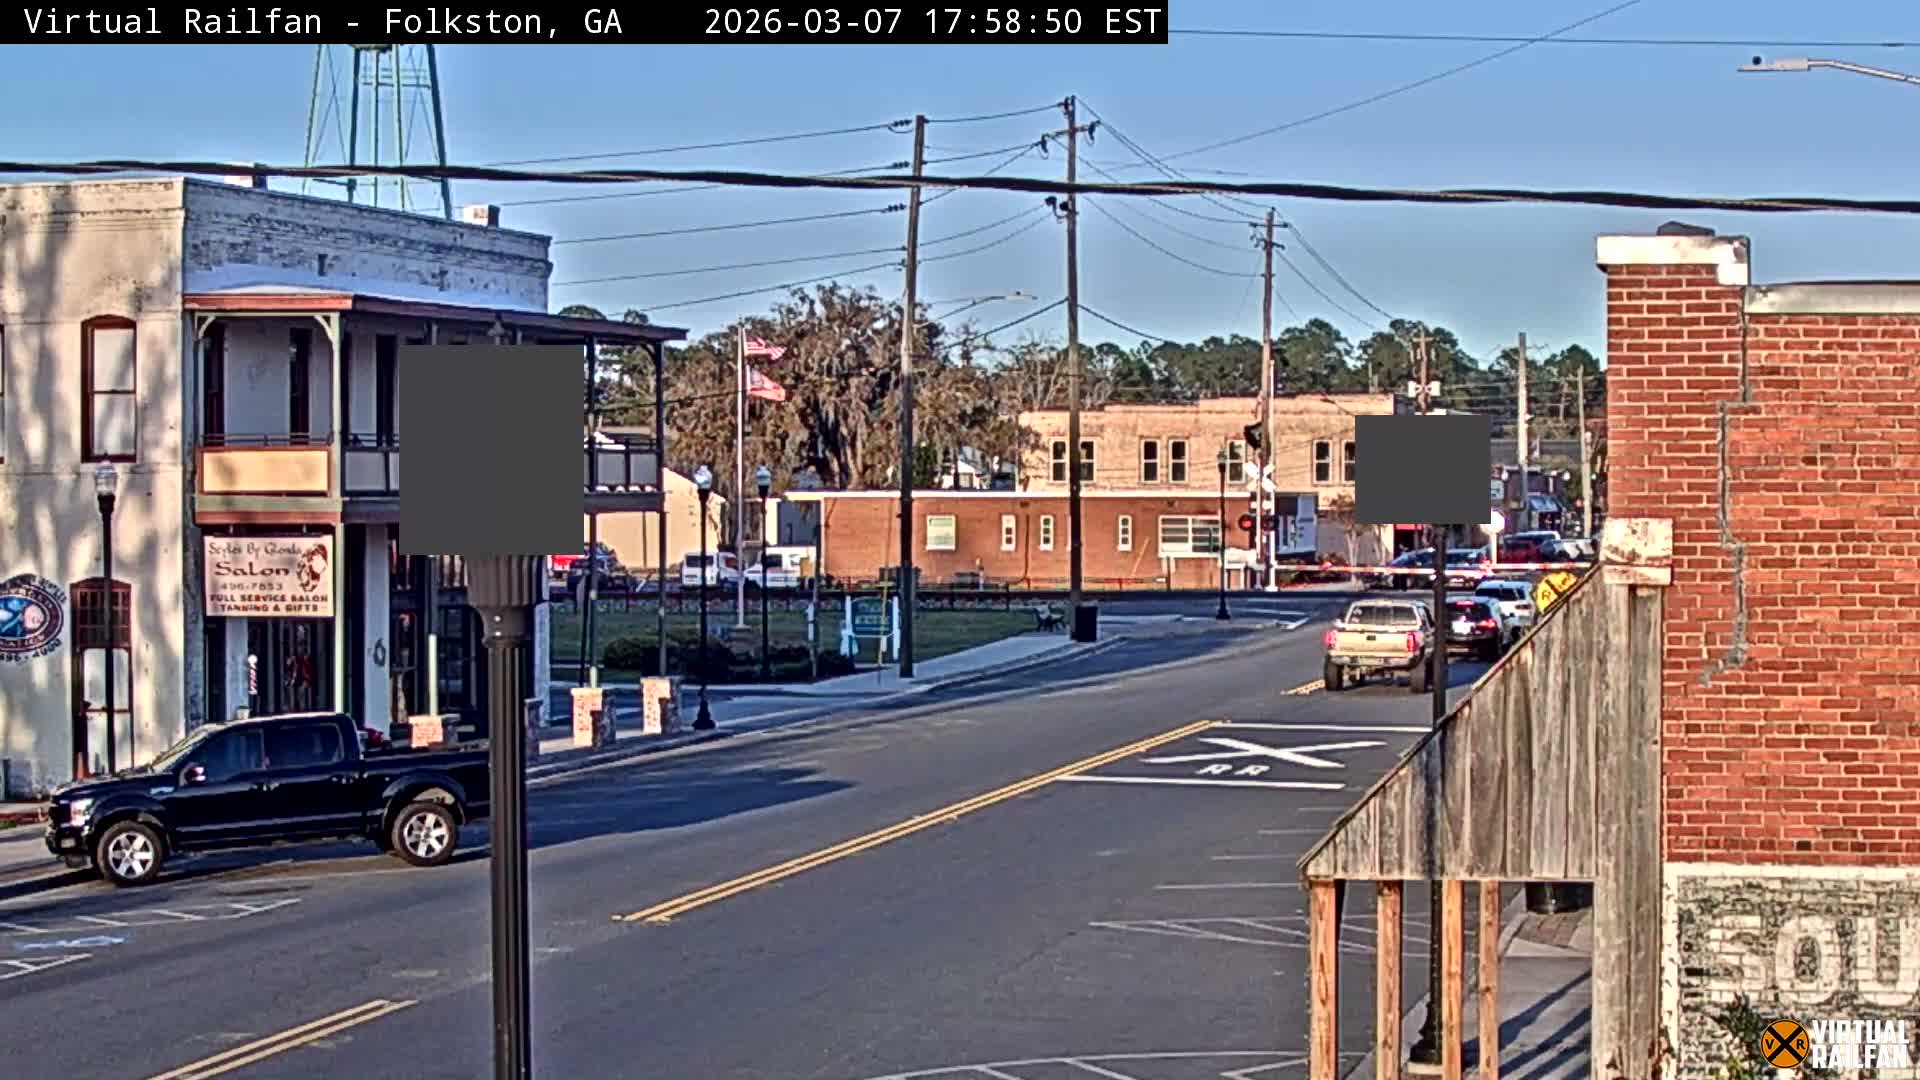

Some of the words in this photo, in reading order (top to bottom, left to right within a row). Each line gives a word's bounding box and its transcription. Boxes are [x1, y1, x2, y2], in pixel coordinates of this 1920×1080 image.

[247, 542, 260, 560] By
[215, 561, 290, 576] Salon
[210, 594, 236, 602] FULL
[240, 594, 287, 602] SERVICE
[291, 594, 329, 602] SALON
[220, 604, 270, 612] TANNING
[285, 604, 319, 612] GIFTS
[1195, 763, 1233, 775] R
[1234, 764, 1271, 776] R
